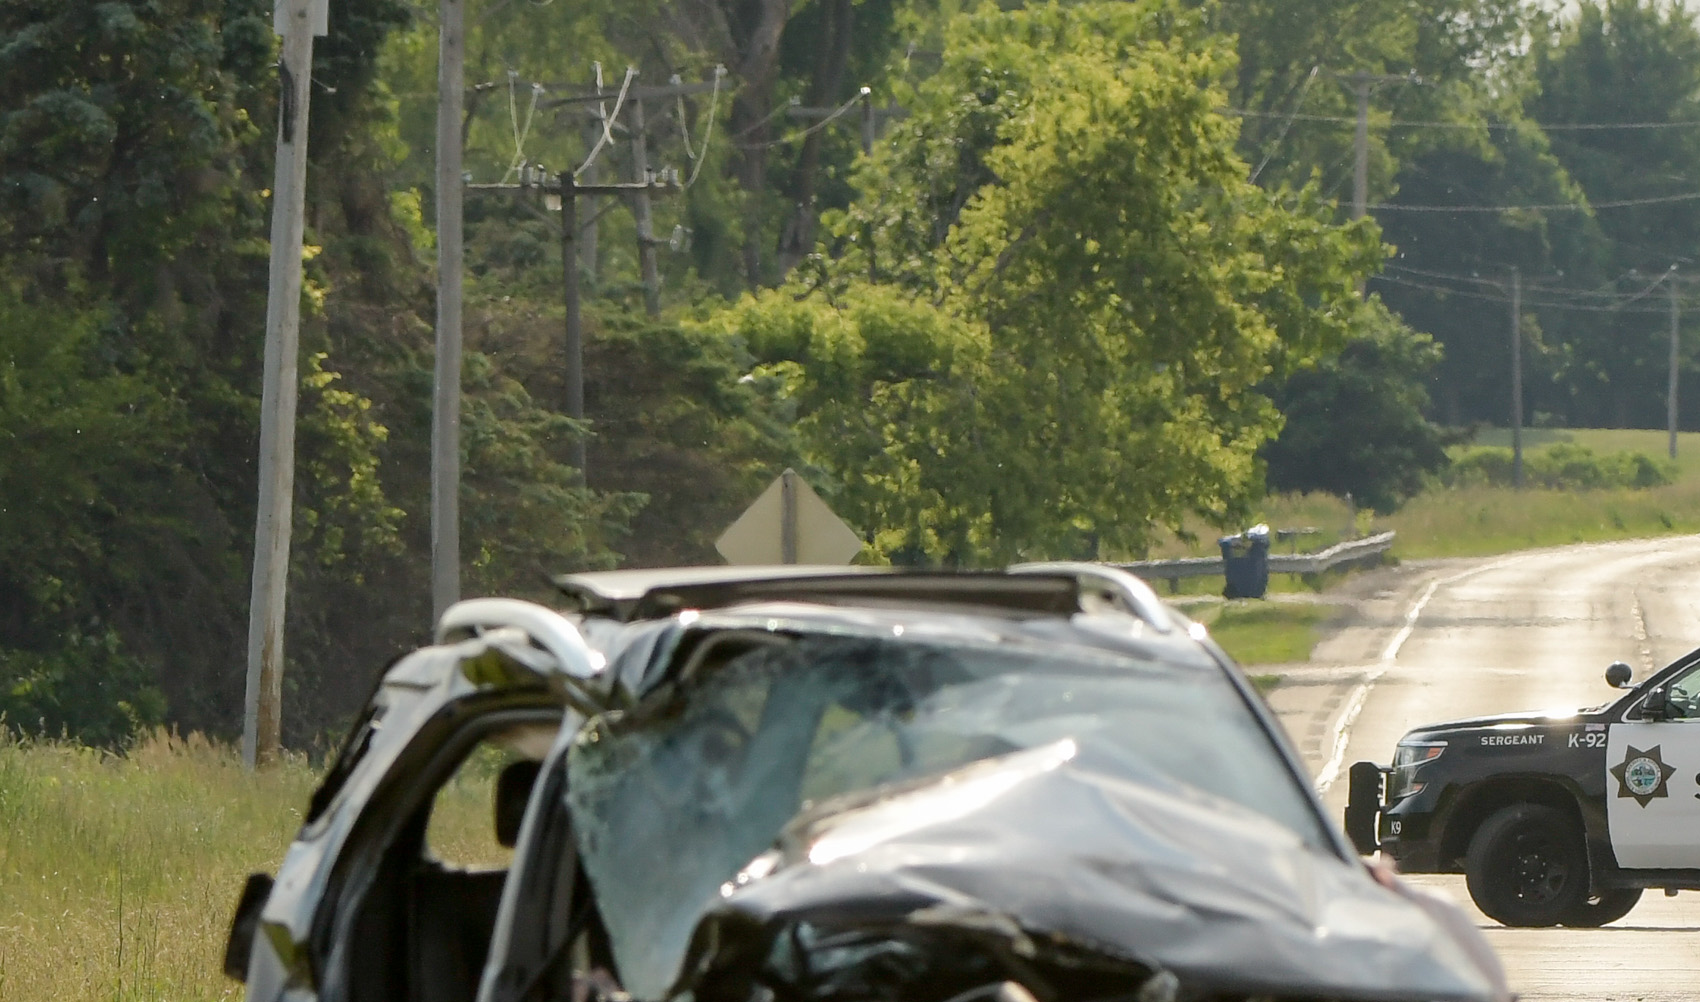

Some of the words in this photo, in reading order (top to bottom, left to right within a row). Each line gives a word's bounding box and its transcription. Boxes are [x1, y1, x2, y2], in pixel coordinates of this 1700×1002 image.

[1480, 734, 1545, 746] SERGEANT
[1567, 732, 1607, 748] K-92
[1390, 820, 1402, 835] K9
